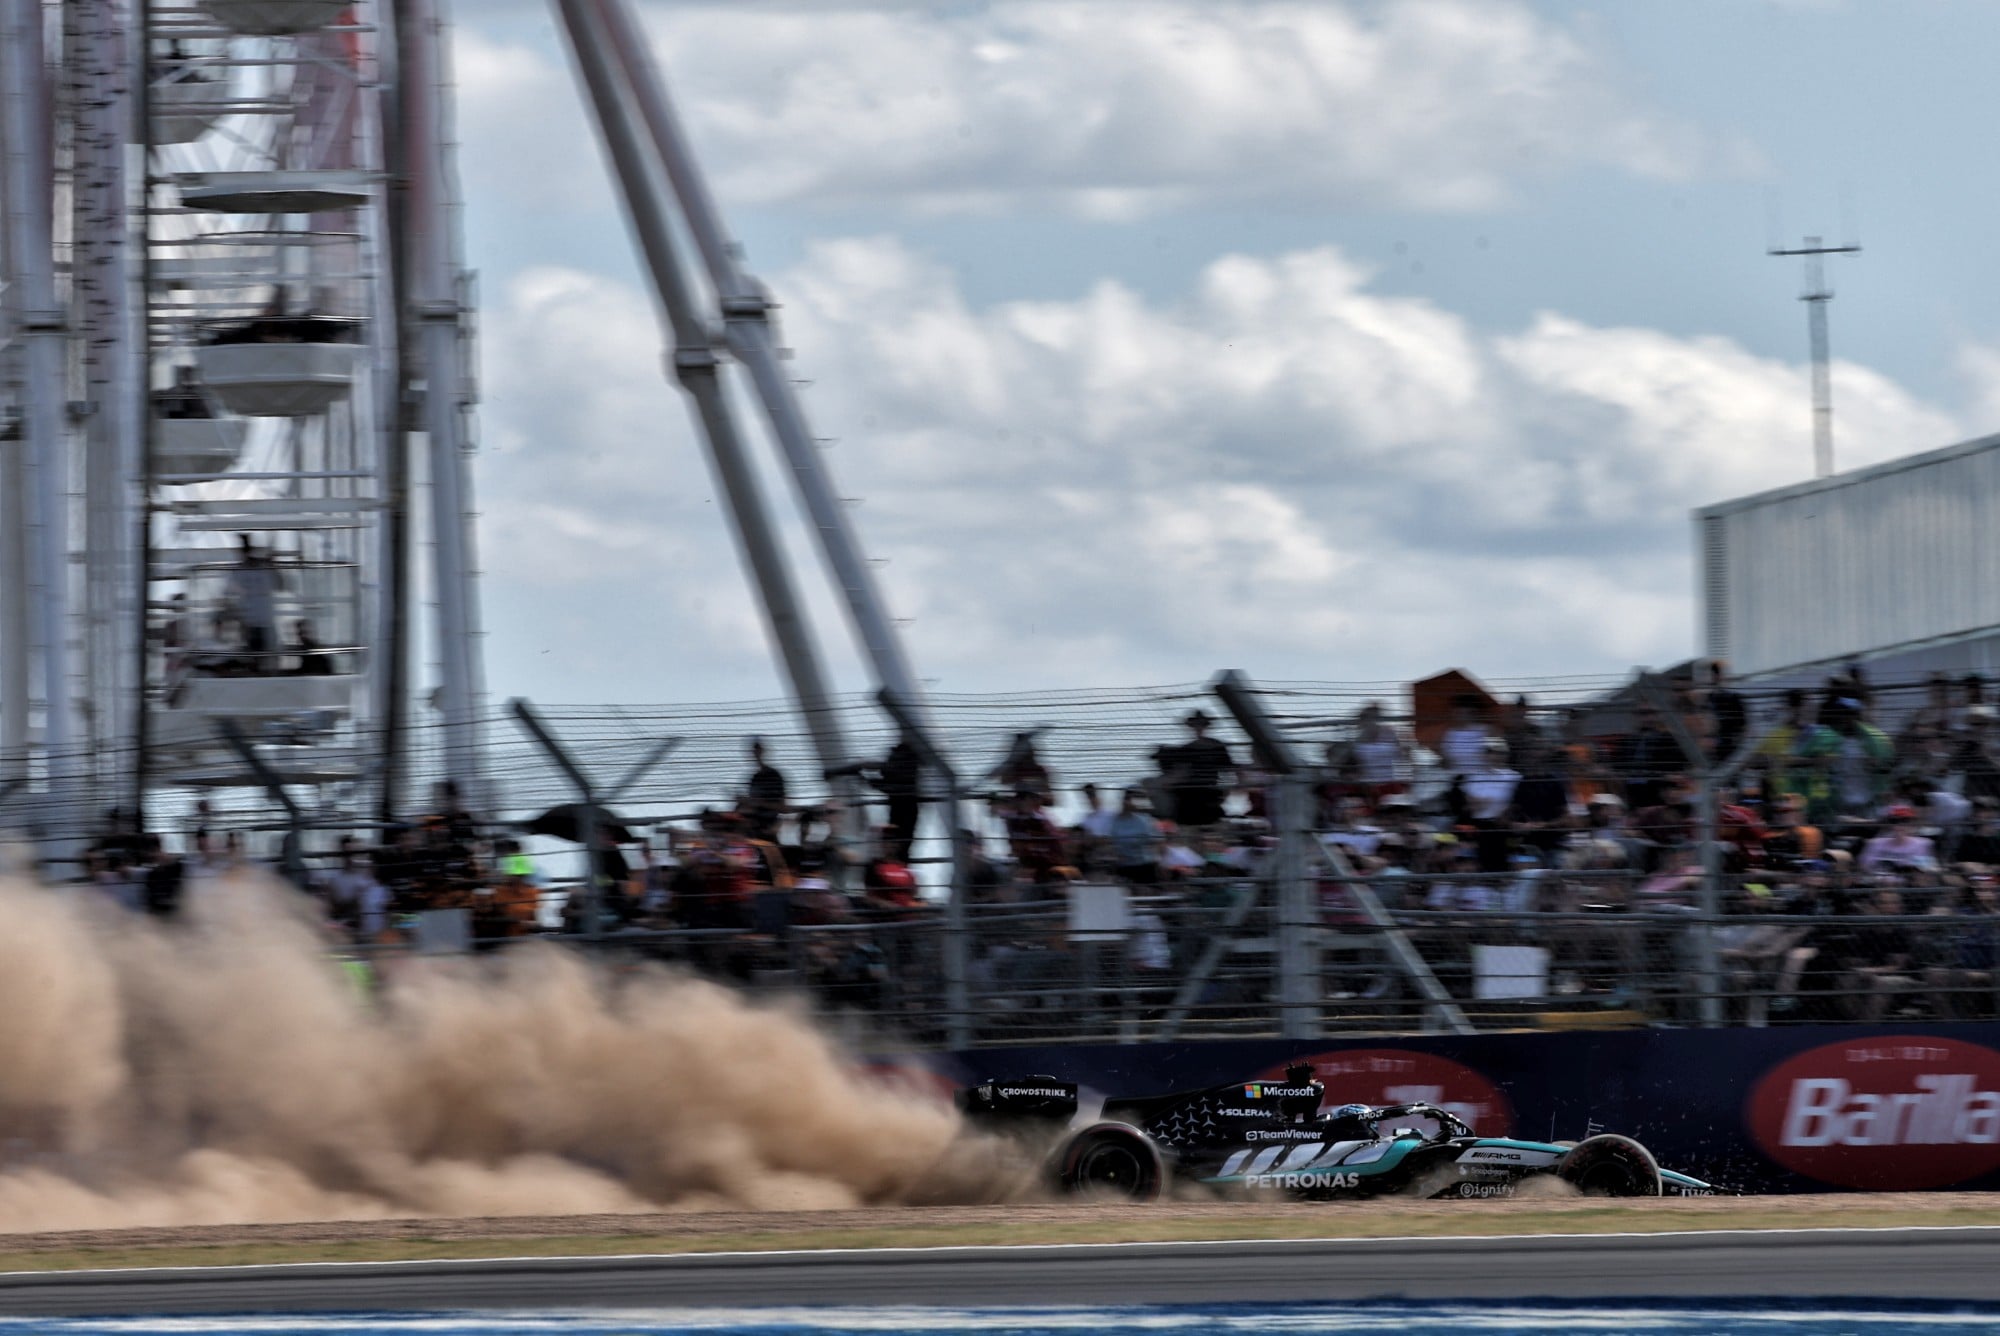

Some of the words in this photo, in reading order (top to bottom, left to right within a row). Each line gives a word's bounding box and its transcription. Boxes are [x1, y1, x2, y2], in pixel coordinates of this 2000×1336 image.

[1002, 1087, 1067, 1097] CROWDSTRIKE
[1263, 1085, 1315, 1097] Microsoft
[1226, 1108, 1265, 1117] SOLERA
[1257, 1129, 1323, 1140] TeamViewer
[1487, 1152, 1521, 1160] AMG
[1245, 1171, 1360, 1190] PETRONAS
